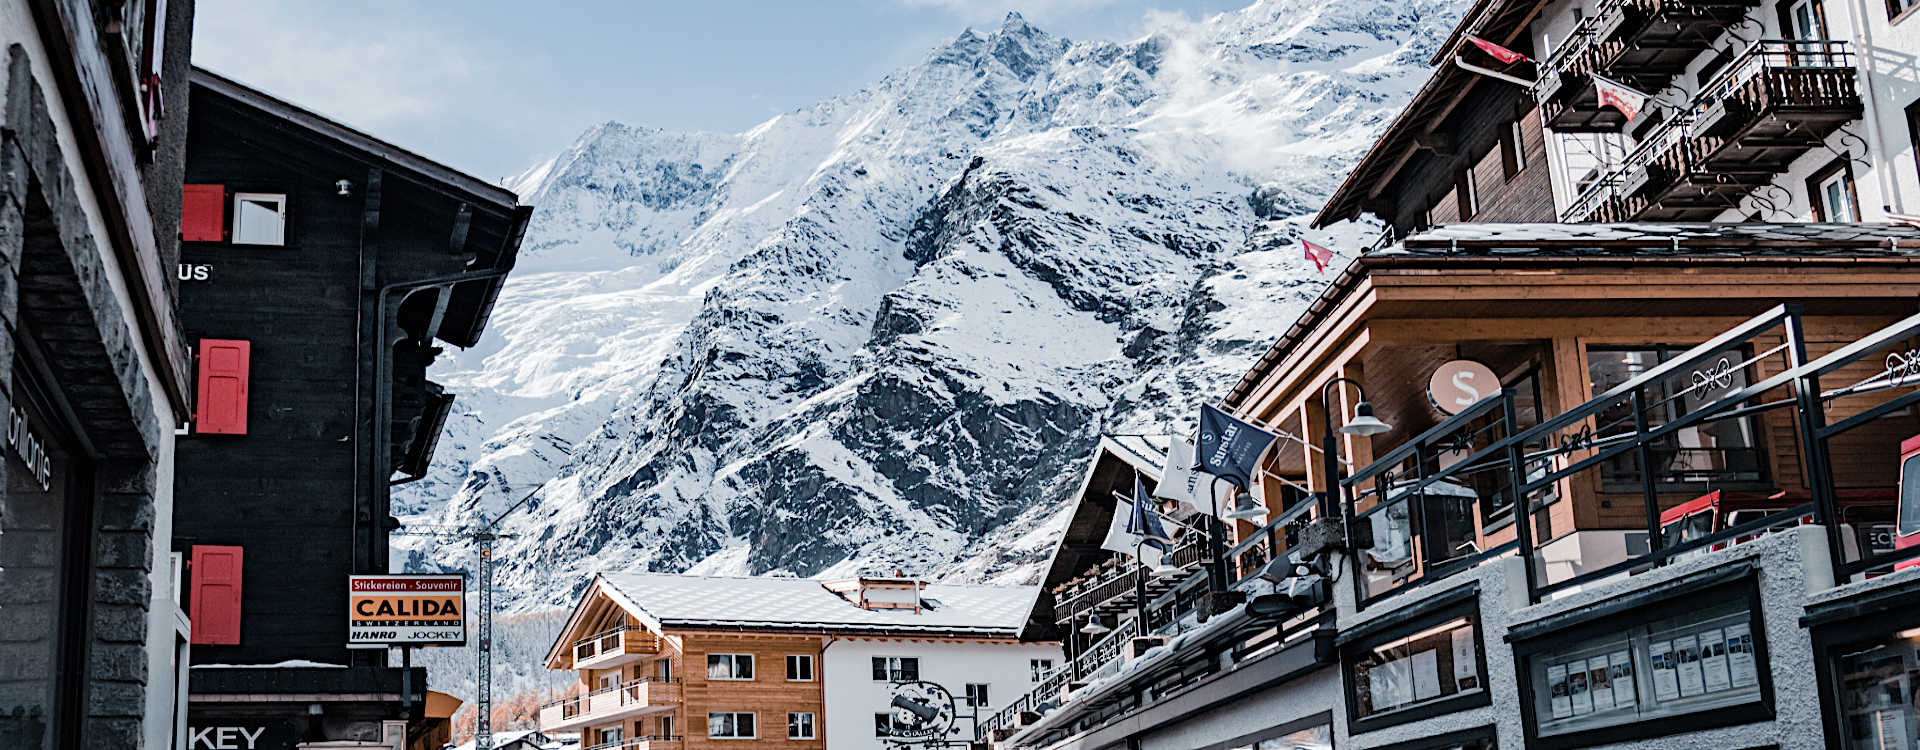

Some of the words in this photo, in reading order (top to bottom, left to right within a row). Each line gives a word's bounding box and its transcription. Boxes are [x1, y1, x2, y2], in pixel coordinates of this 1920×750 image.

[1452, 371, 1480, 406] S
[354, 580, 407, 590] Stickereien
[415, 580, 458, 590] Souvenir
[356, 599, 459, 616] CALIDA
[351, 631, 398, 640] HANRO
[407, 631, 461, 640] JOCKEY
[188, 726, 266, 750] KEY
